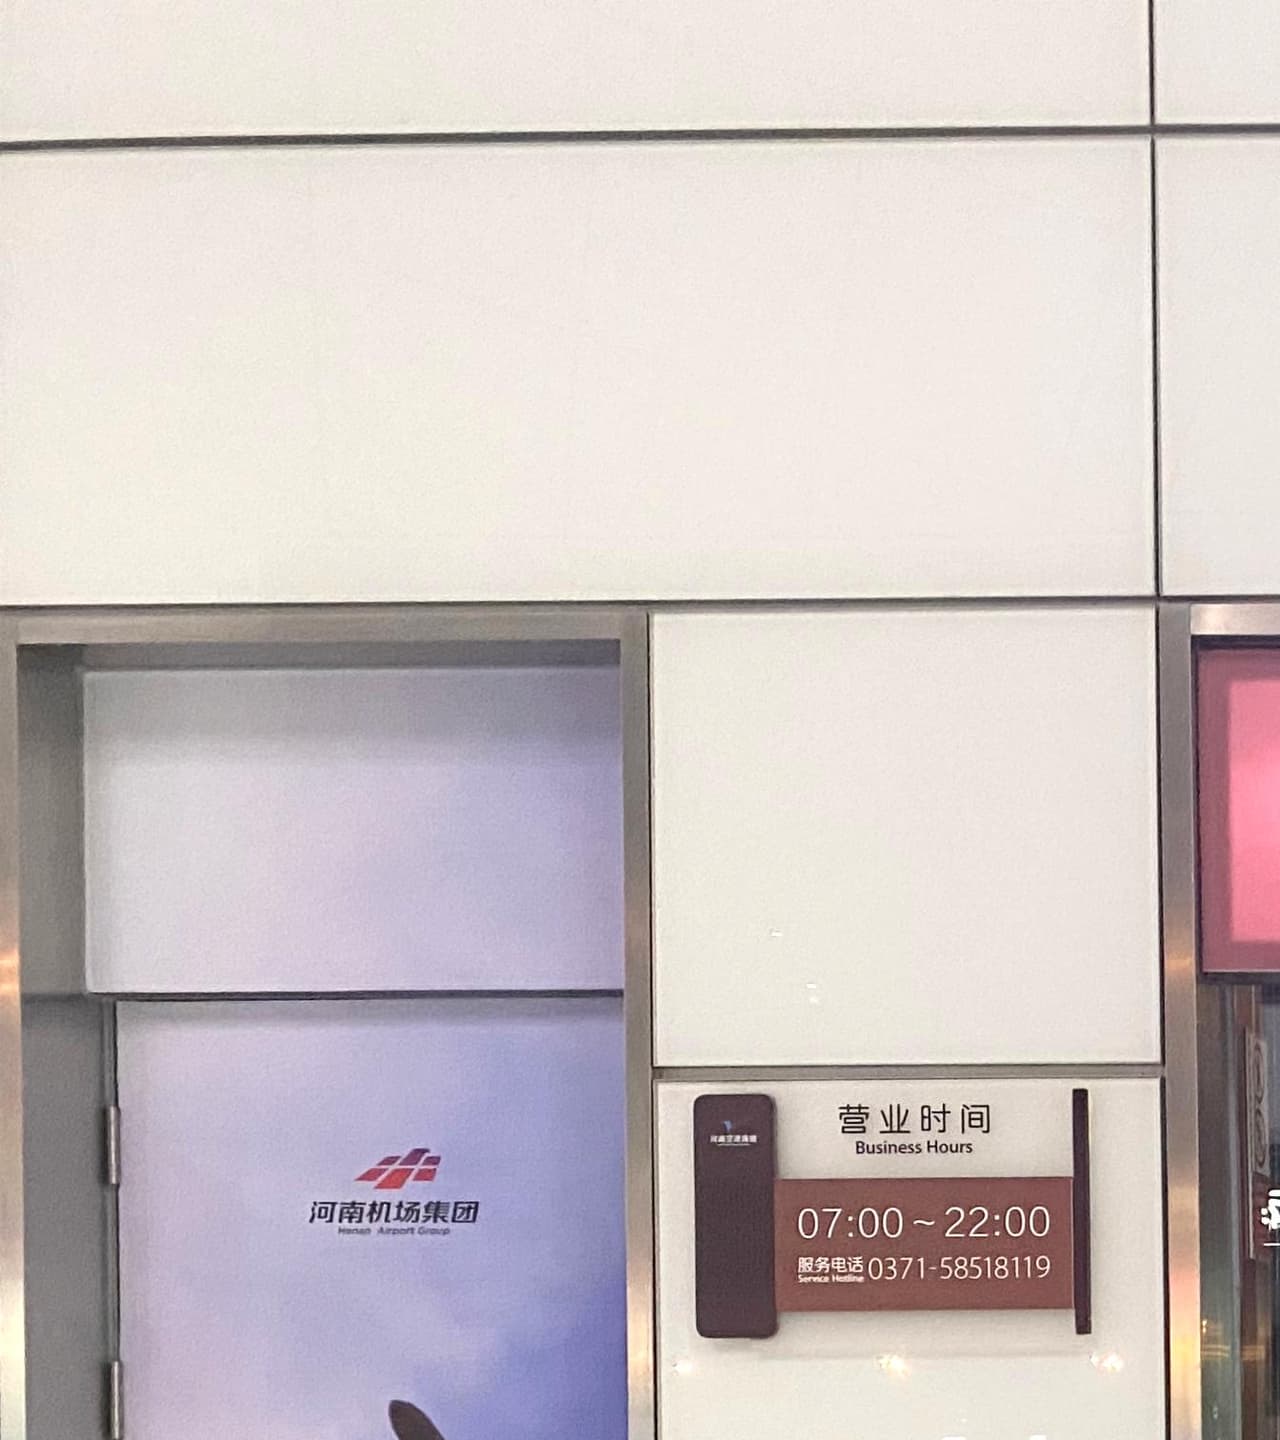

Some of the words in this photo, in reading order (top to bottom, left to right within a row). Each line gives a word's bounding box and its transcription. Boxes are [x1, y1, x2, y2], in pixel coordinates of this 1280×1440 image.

[838, 1103, 991, 1135] 营业时间
[855, 1140, 922, 1155] Business
[926, 1140, 973, 1155] Hours
[309, 1200, 480, 1224] 河南机场集团
[797, 1206, 904, 1239] 07:00
[944, 1206, 1051, 1238] 22:00
[377, 1226, 415, 1236] Airport
[418, 1226, 451, 1236] Group
[798, 1255, 865, 1274] 服务电话
[867, 1255, 1051, 1281] 0371-58518119
